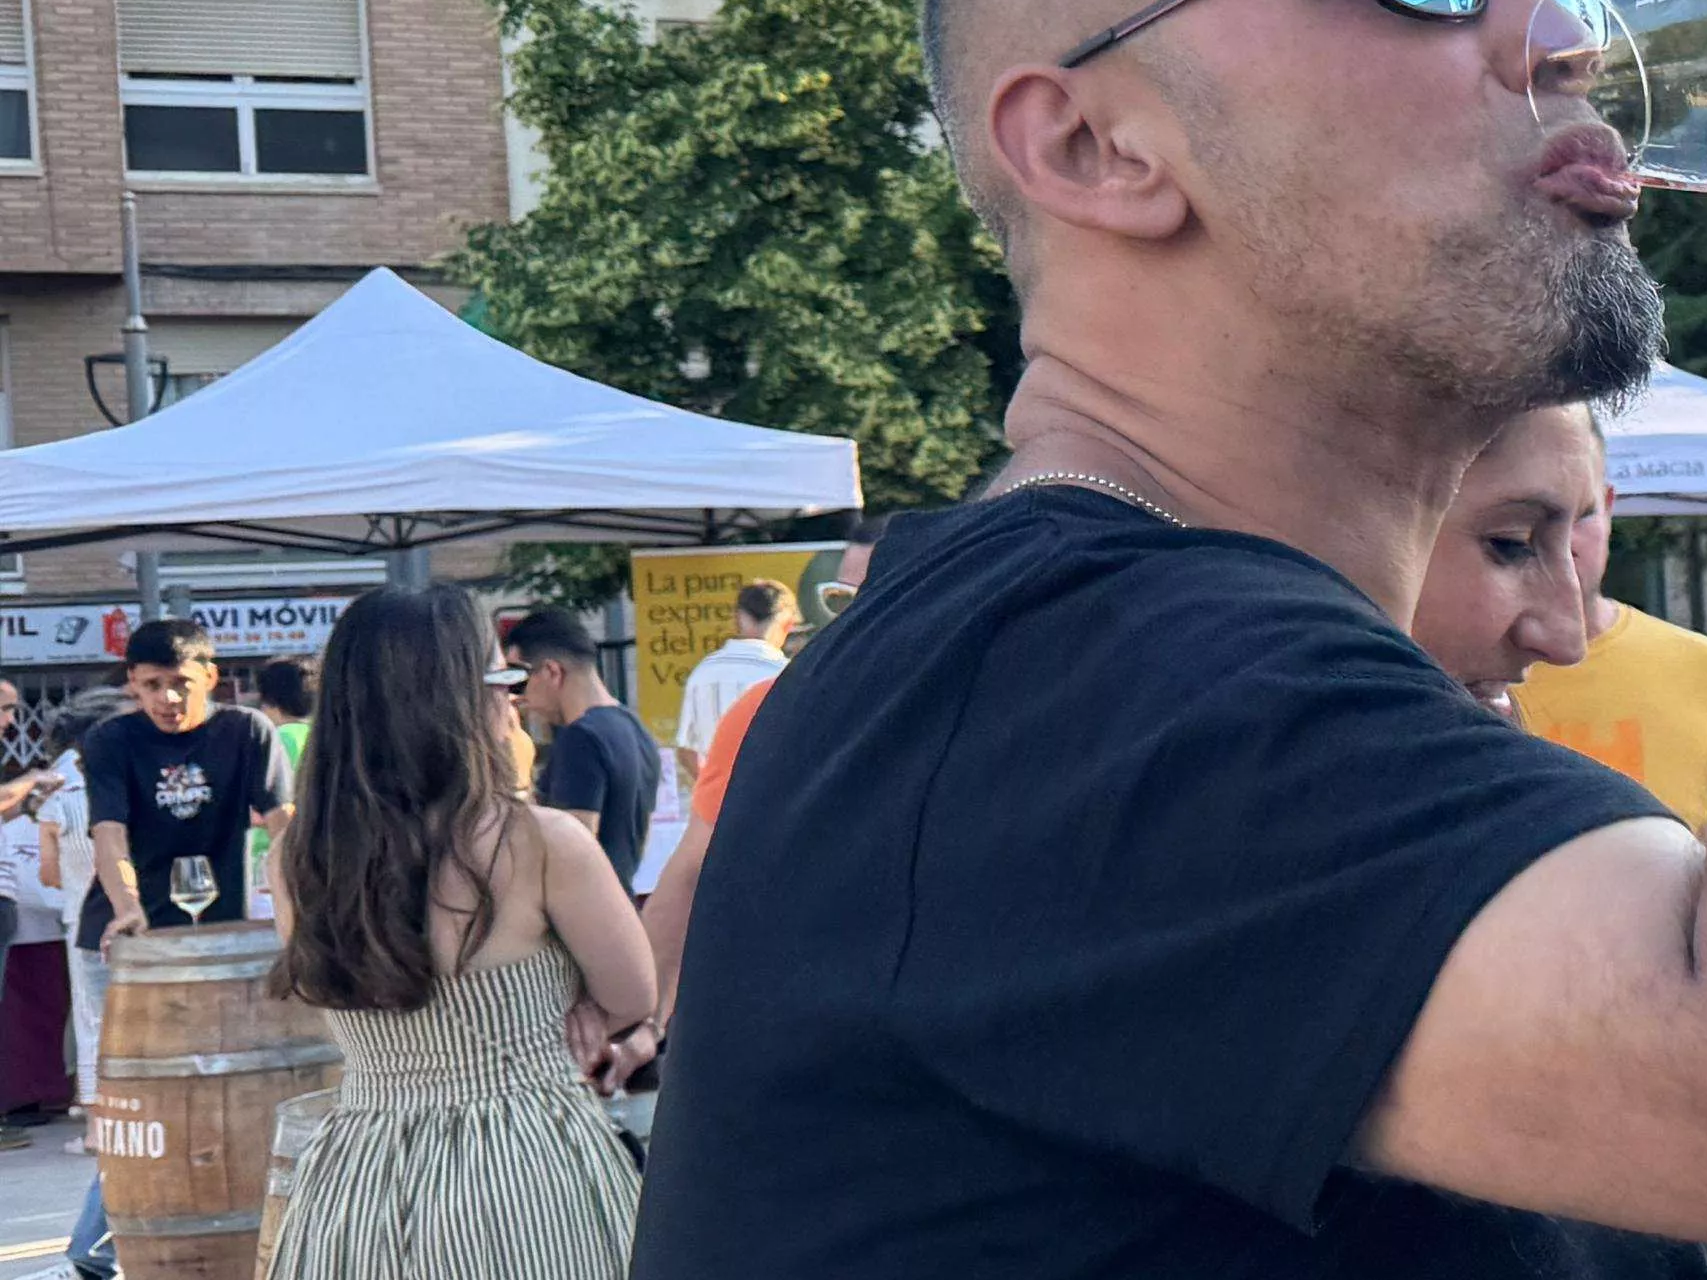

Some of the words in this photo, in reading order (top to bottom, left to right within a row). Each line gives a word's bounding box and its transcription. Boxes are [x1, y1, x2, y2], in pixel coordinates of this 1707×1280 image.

[647, 573, 676, 593] La
[648, 604, 733, 628] expre
[650, 628, 694, 655] del
